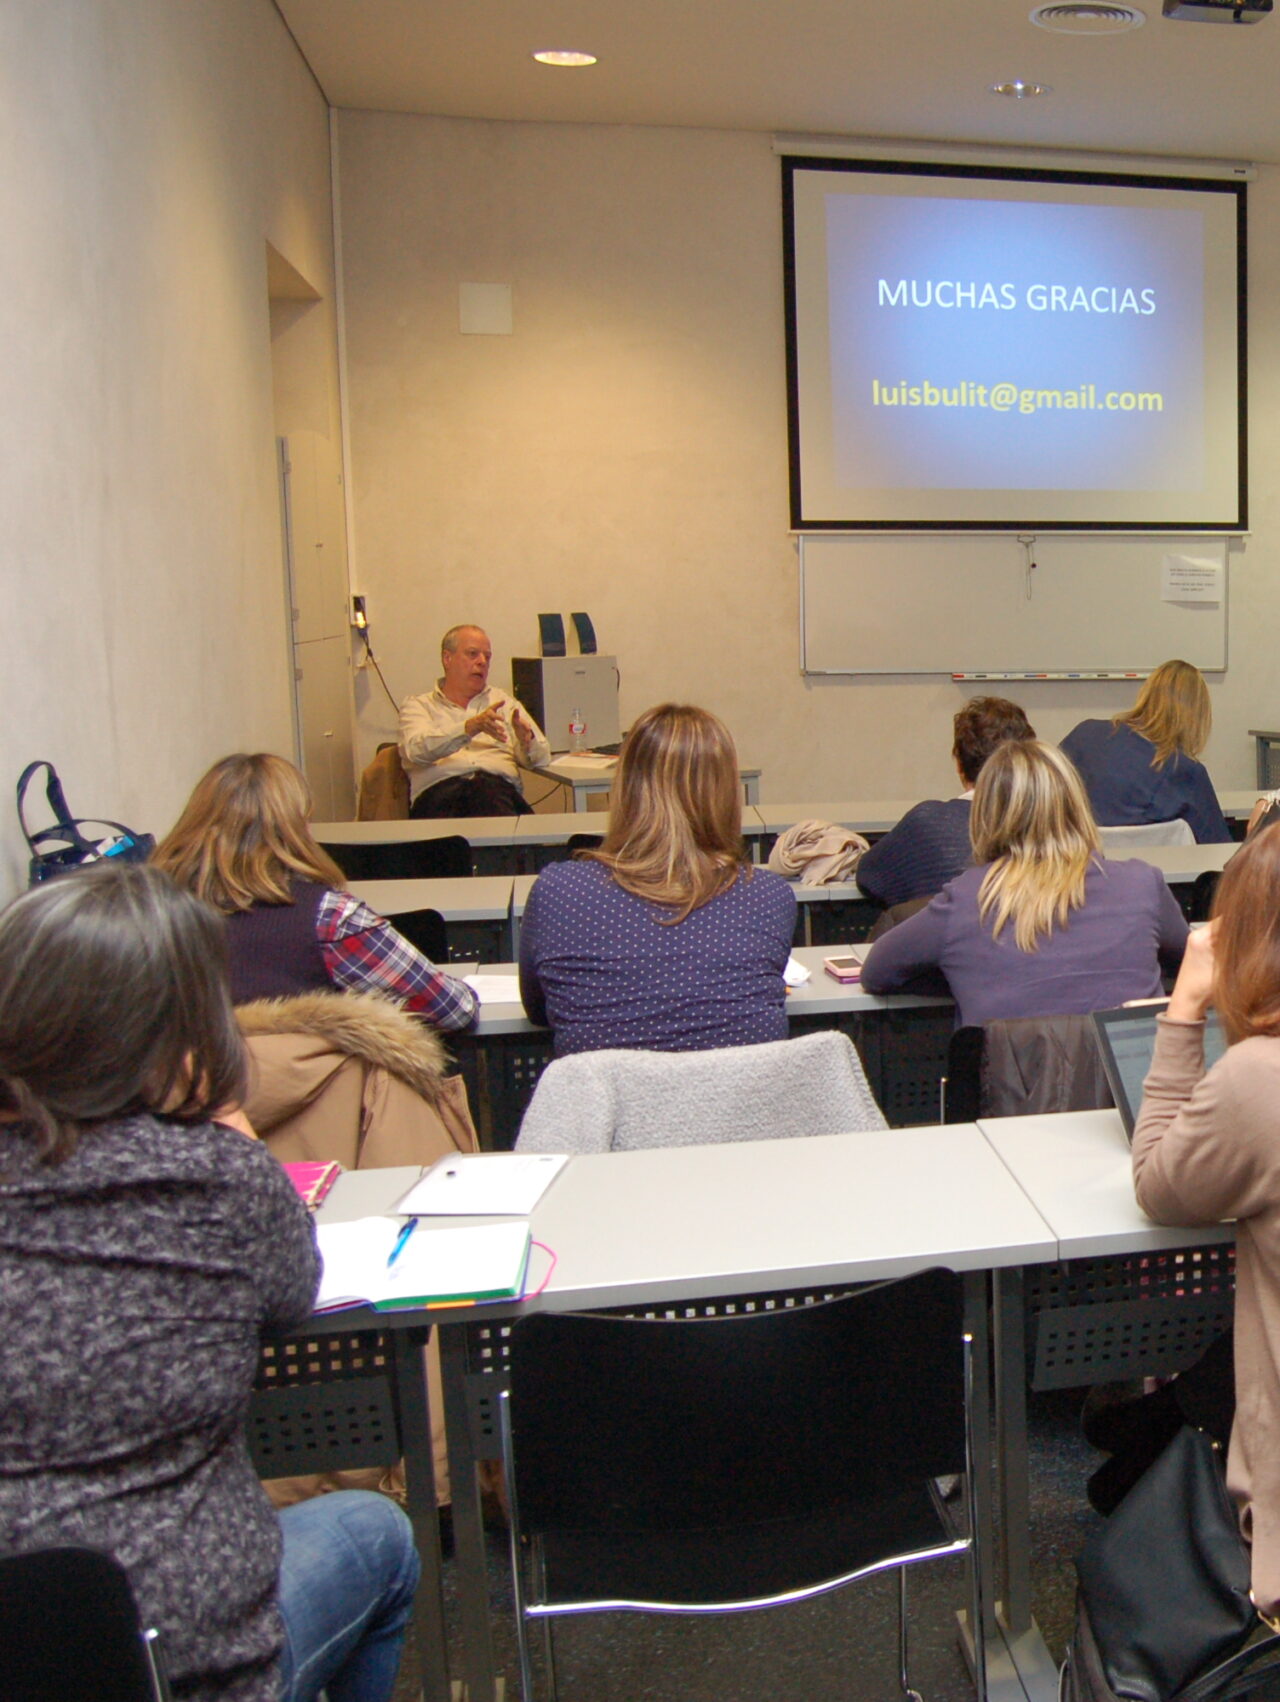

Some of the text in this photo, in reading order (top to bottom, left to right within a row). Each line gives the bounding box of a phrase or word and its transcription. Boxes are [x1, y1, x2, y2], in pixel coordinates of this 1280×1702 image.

[878, 278, 1157, 315] MUCHAS GRACIAS
[872, 380, 1163, 413] luisbulit@gmail.com
